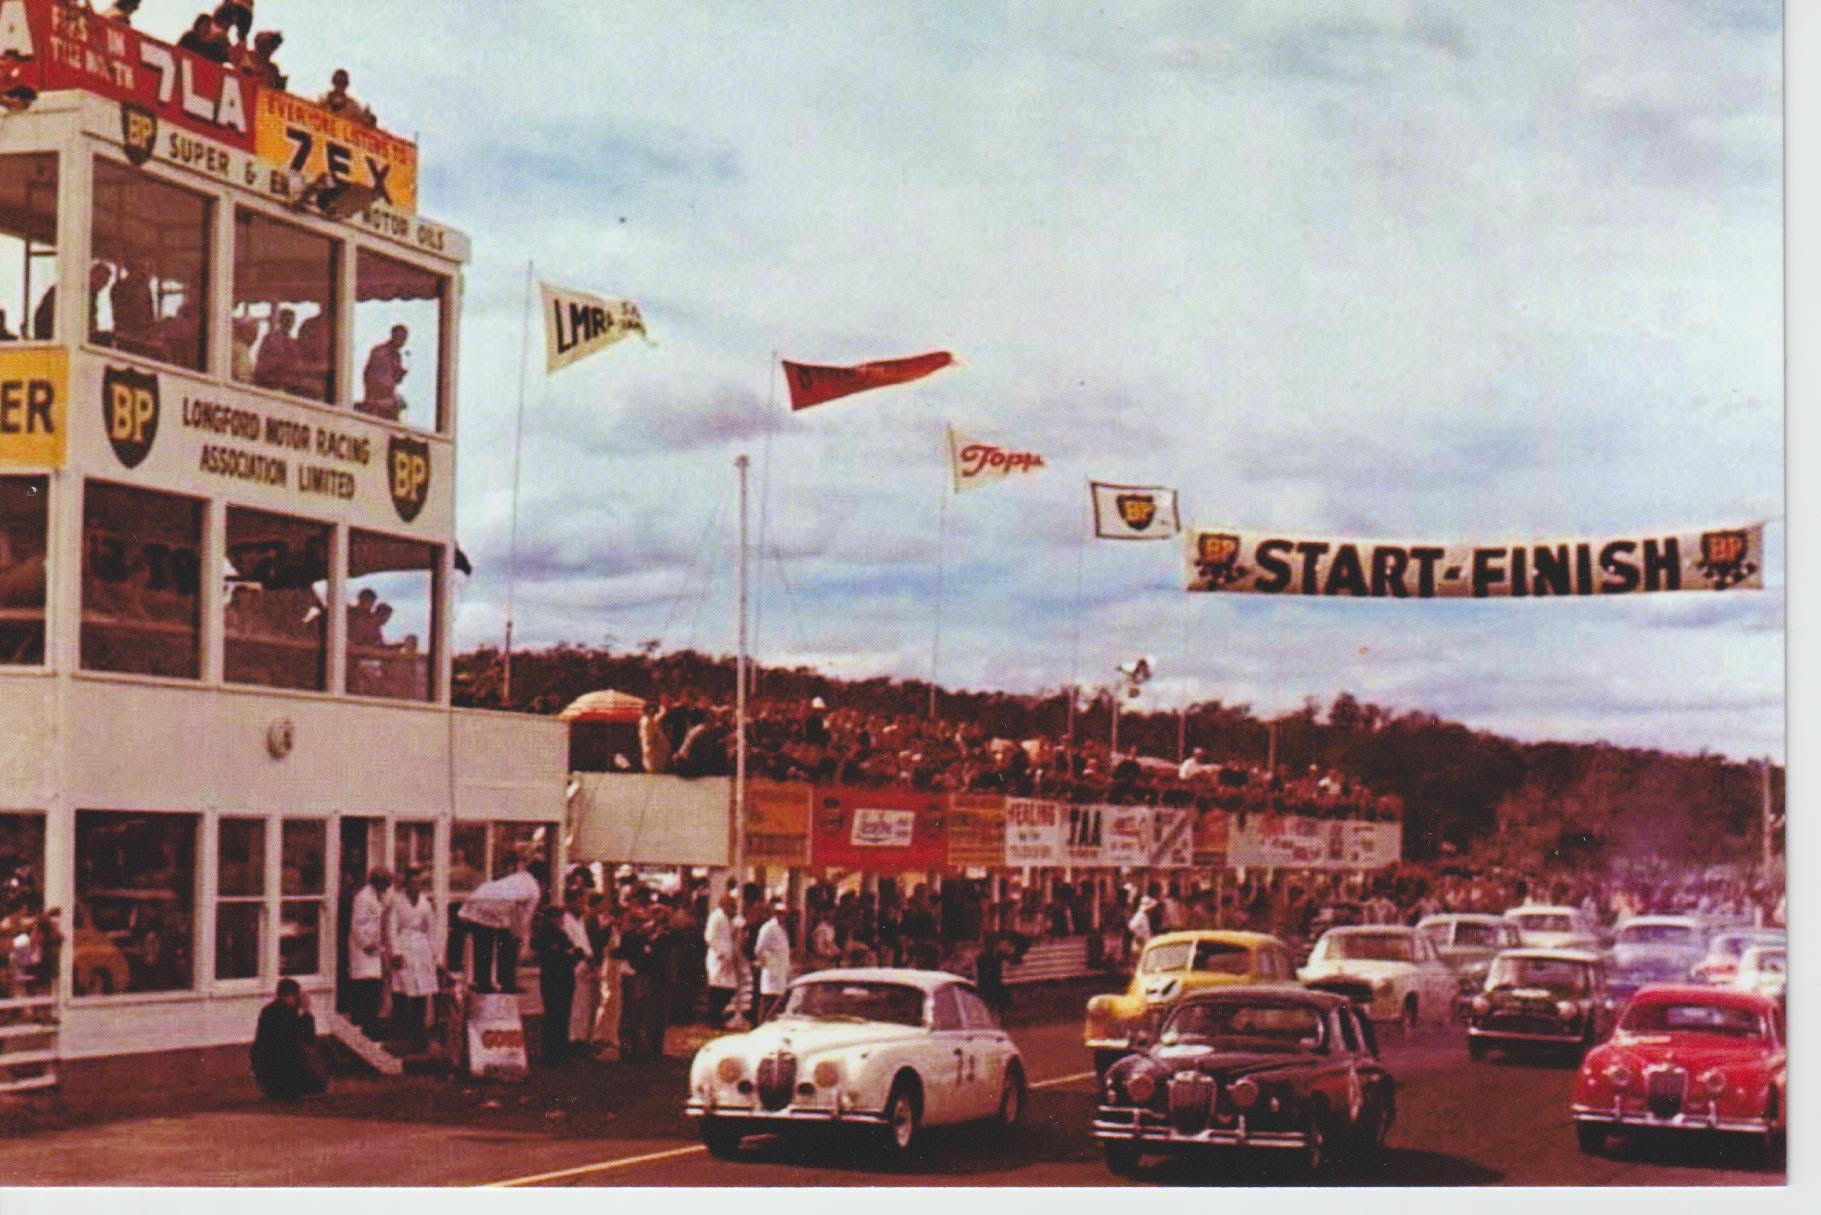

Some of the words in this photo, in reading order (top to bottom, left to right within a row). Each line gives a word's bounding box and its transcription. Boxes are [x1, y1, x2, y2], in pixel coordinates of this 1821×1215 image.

[141, 40, 248, 133] 7LA
[169, 131, 230, 178] SUPER
[416, 222, 444, 252] OILS
[0, 379, 55, 434] ER
[111, 382, 153, 443] BP
[182, 396, 261, 441] LONGFORD
[265, 415, 311, 451] MOTOR
[316, 427, 371, 465] RACING
[200, 442, 287, 487] ASSOCIATION
[298, 462, 356, 501] LIMITED
[394, 451, 425, 501] BP
